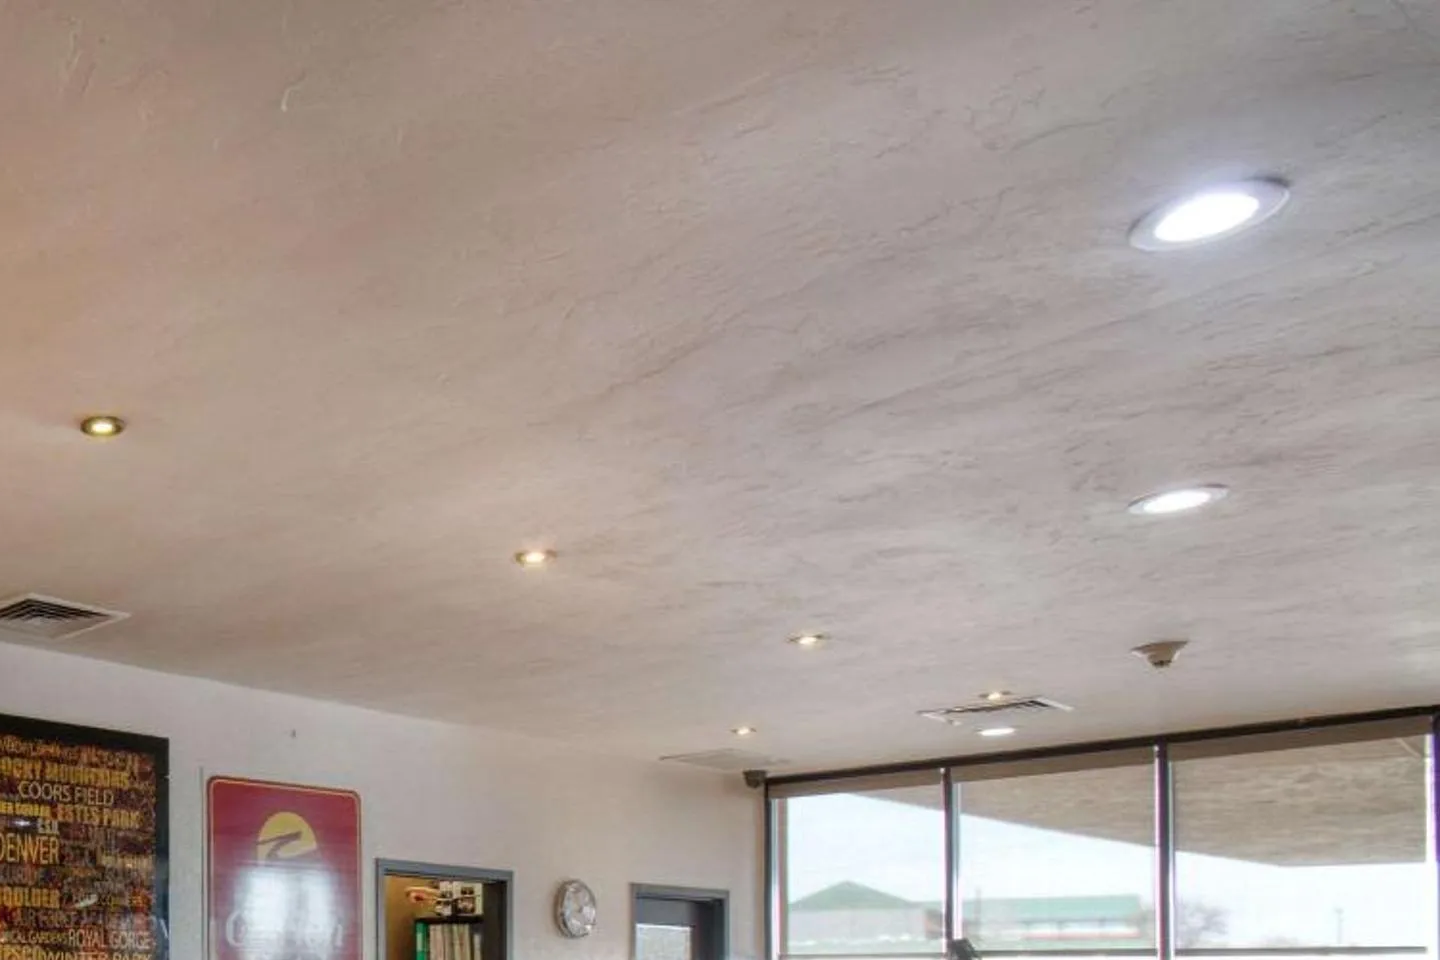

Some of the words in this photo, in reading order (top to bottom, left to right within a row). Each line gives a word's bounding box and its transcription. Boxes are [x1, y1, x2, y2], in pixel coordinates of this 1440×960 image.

[18, 781, 72, 802] COORS
[74, 786, 114, 806] FIELD
[68, 927, 107, 949] ROYAL
